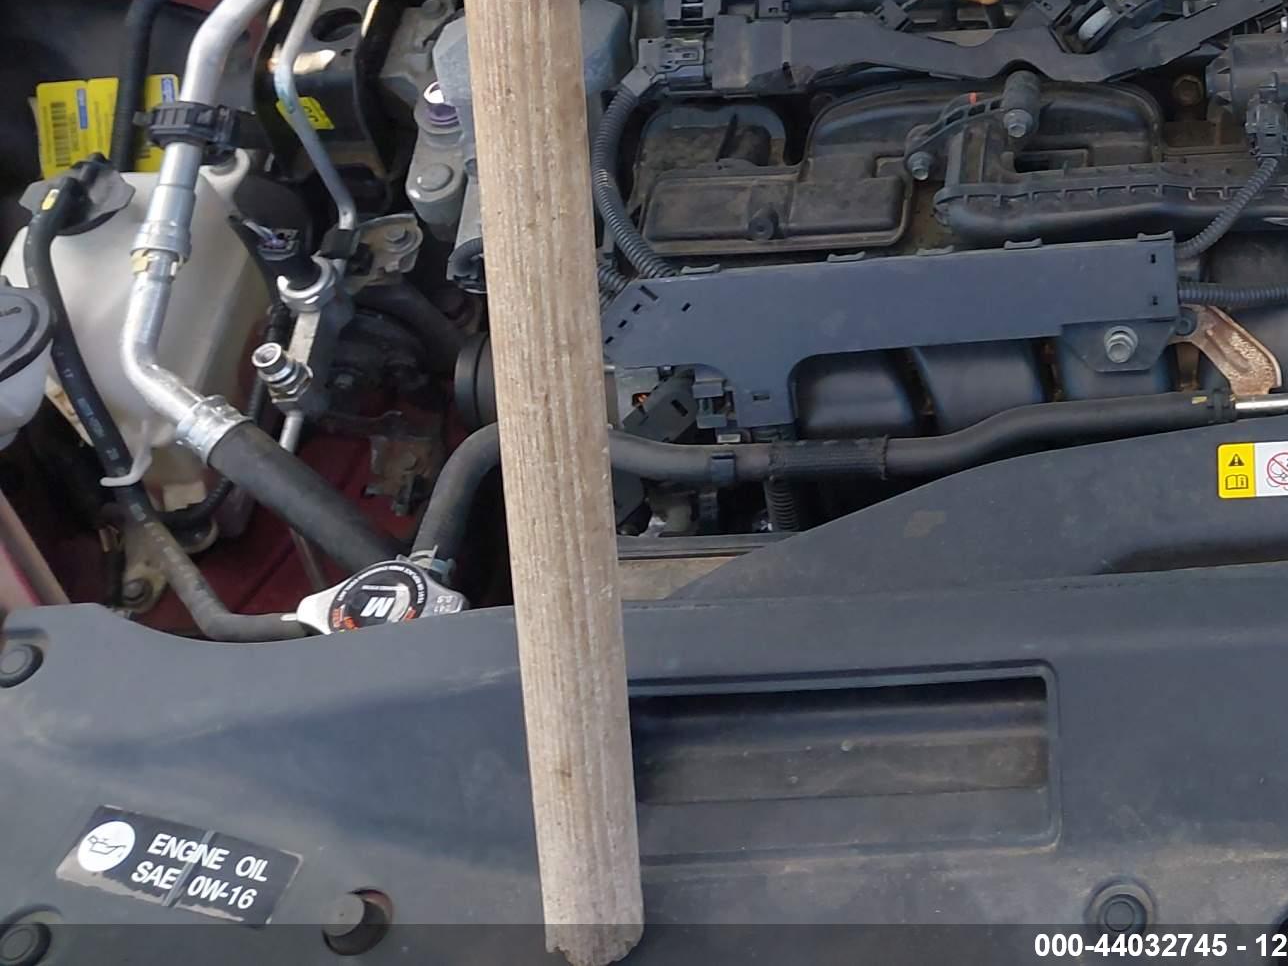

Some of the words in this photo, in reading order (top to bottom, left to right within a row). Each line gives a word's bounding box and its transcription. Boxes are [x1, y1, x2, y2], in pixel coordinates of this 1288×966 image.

[148, 833, 229, 870] ENGINE
[235, 856, 269, 882] OIL
[131, 861, 182, 890] SAE
[187, 875, 257, 910] 0W-16
